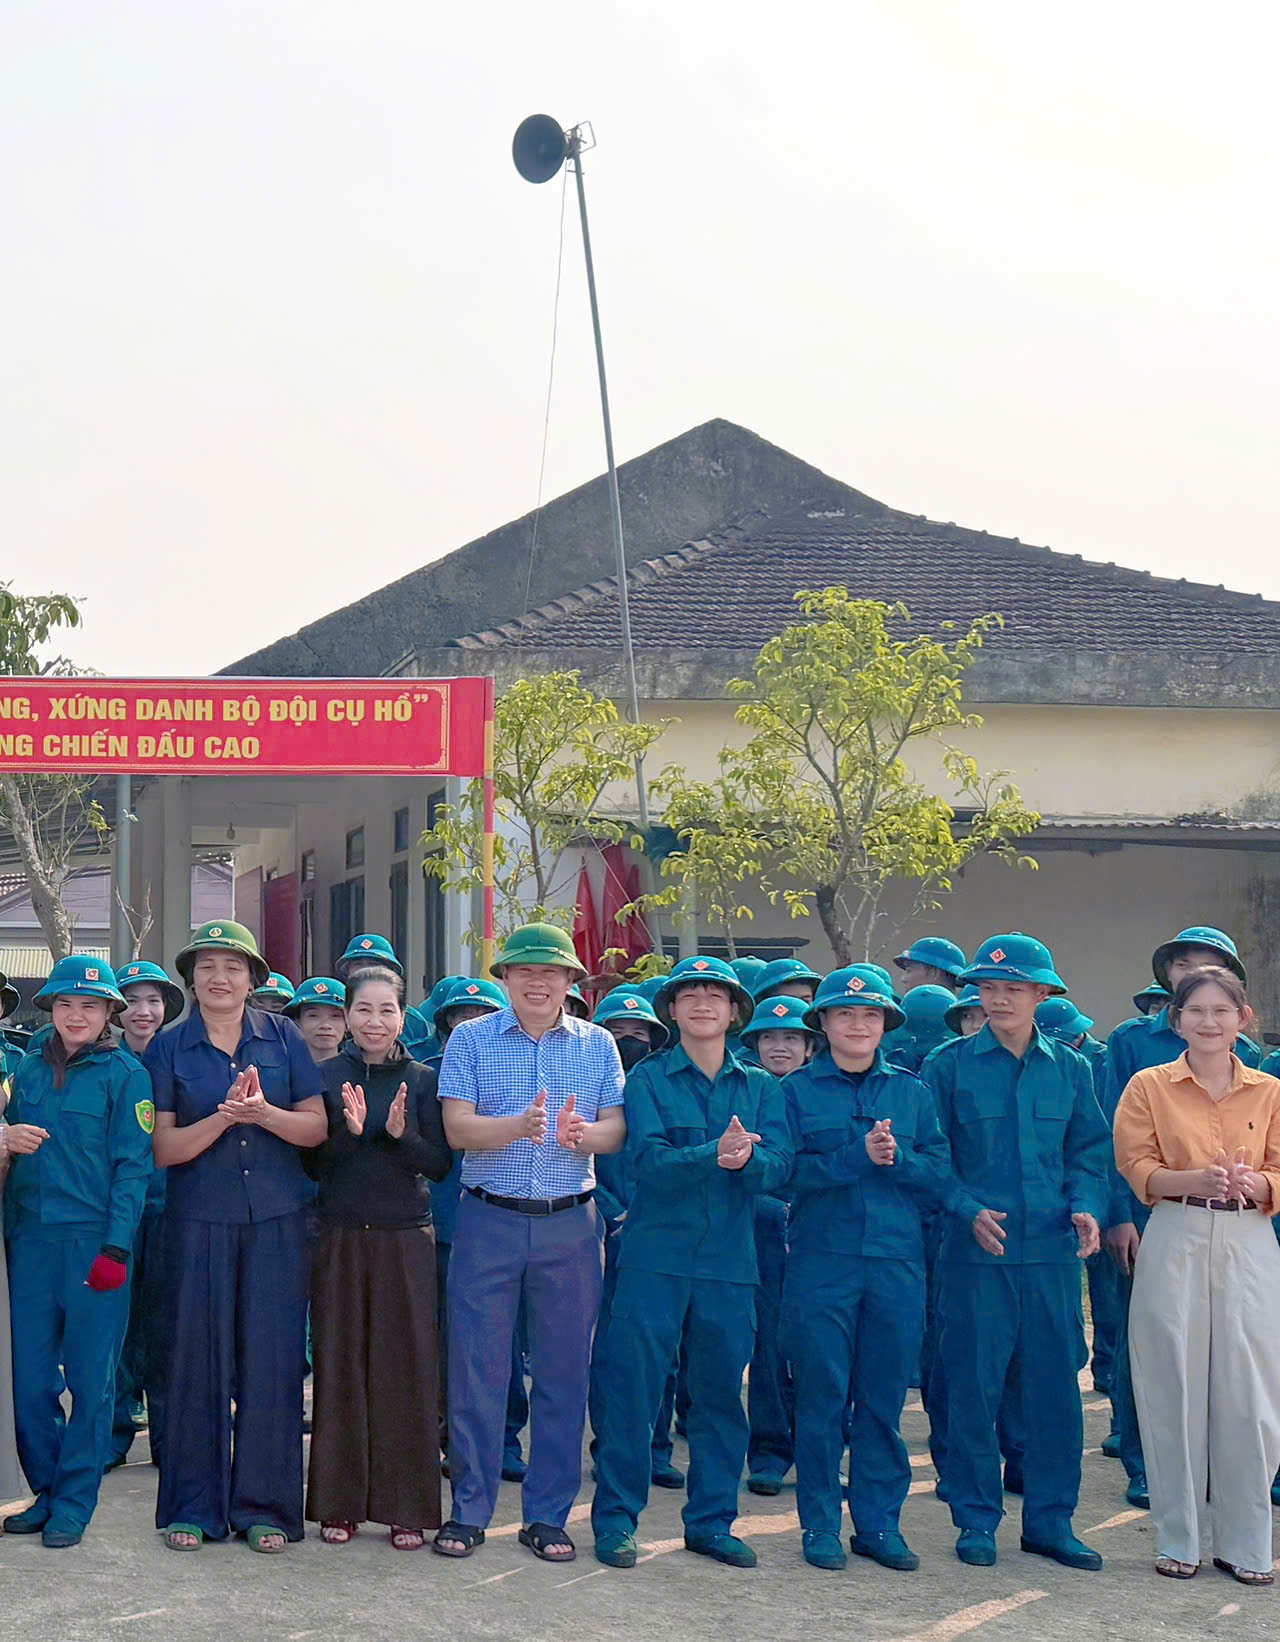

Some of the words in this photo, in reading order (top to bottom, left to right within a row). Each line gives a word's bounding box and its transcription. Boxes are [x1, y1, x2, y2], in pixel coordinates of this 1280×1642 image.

[48, 692, 127, 721] XỨNG
[136, 698, 213, 722] DANH
[222, 694, 261, 727] BỘ
[268, 694, 317, 727] ĐỘI
[327, 699, 365, 727] CỤ
[374, 692, 429, 722] HỒ”
[43, 727, 130, 758] CHIẾN
[137, 727, 195, 759] ĐẤU
[204, 736, 260, 759] CAO
